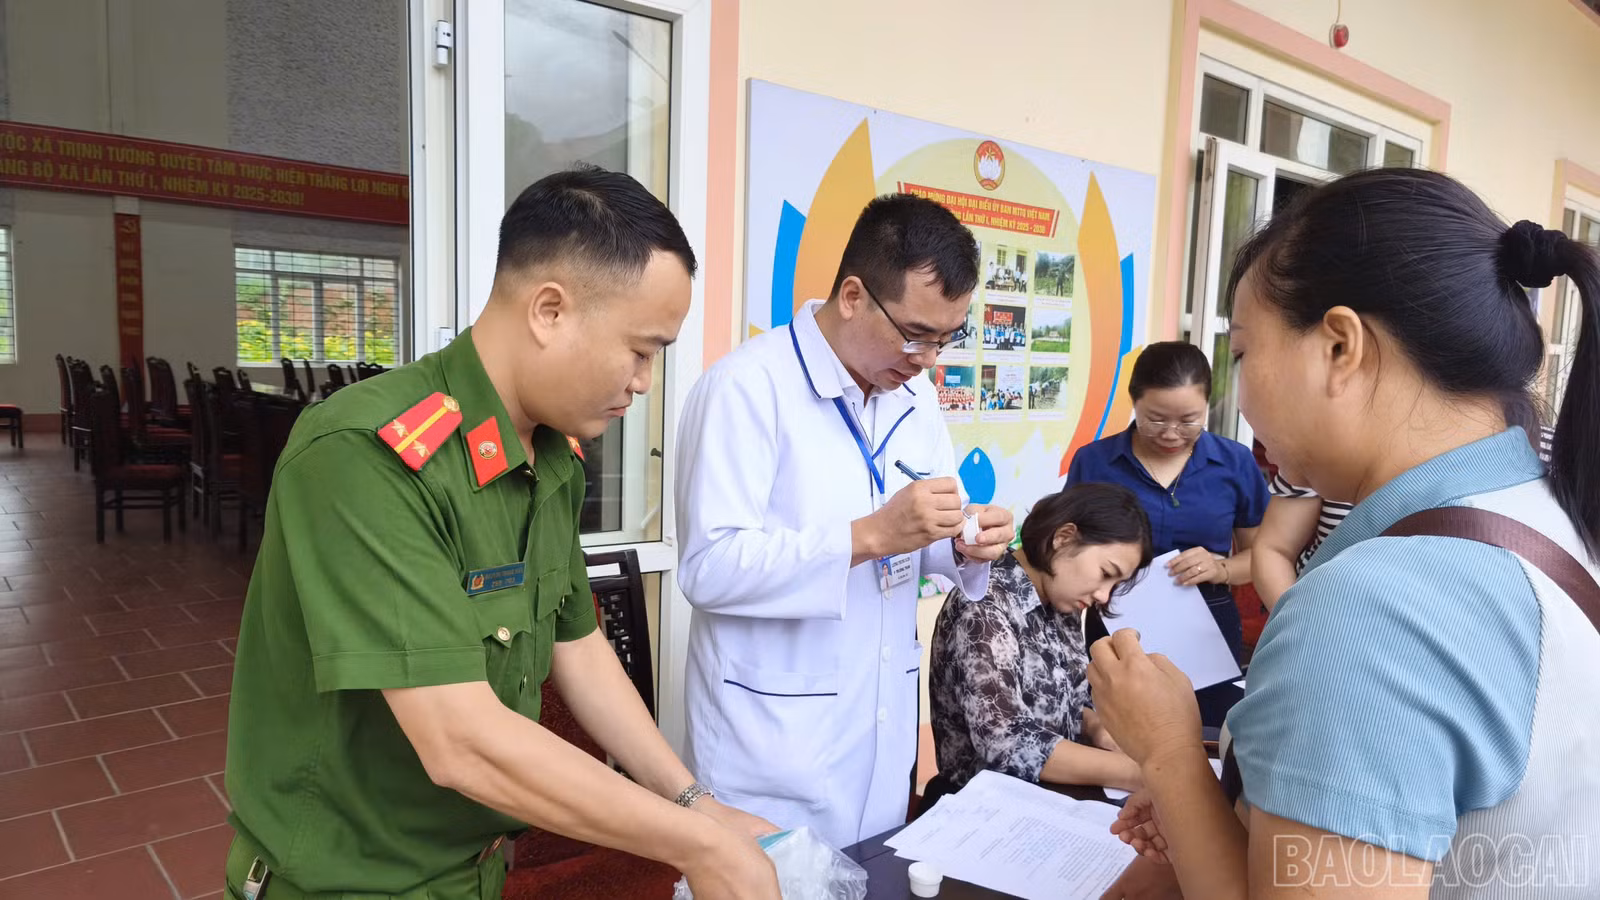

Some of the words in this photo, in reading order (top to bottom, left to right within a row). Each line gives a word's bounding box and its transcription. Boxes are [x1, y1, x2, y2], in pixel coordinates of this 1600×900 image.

[32, 159, 54, 181] BỘ
[118, 169, 146, 188] THỨ
[163, 175, 208, 195] NHIỆM
[58, 140, 103, 161] TRỊNH
[159, 152, 203, 172] QUYẾT
[207, 157, 236, 176] TÂM
[240, 163, 272, 183] THỰC
[275, 167, 306, 187] HIỆN
[351, 178, 369, 195] LỢI
[372, 181, 399, 199] NGHỊ
[1000, 204, 1012, 214] BAN
[1038, 211, 1050, 221] NAM
[1017, 222, 1029, 231] 2025
[1033, 224, 1046, 234] 2030
